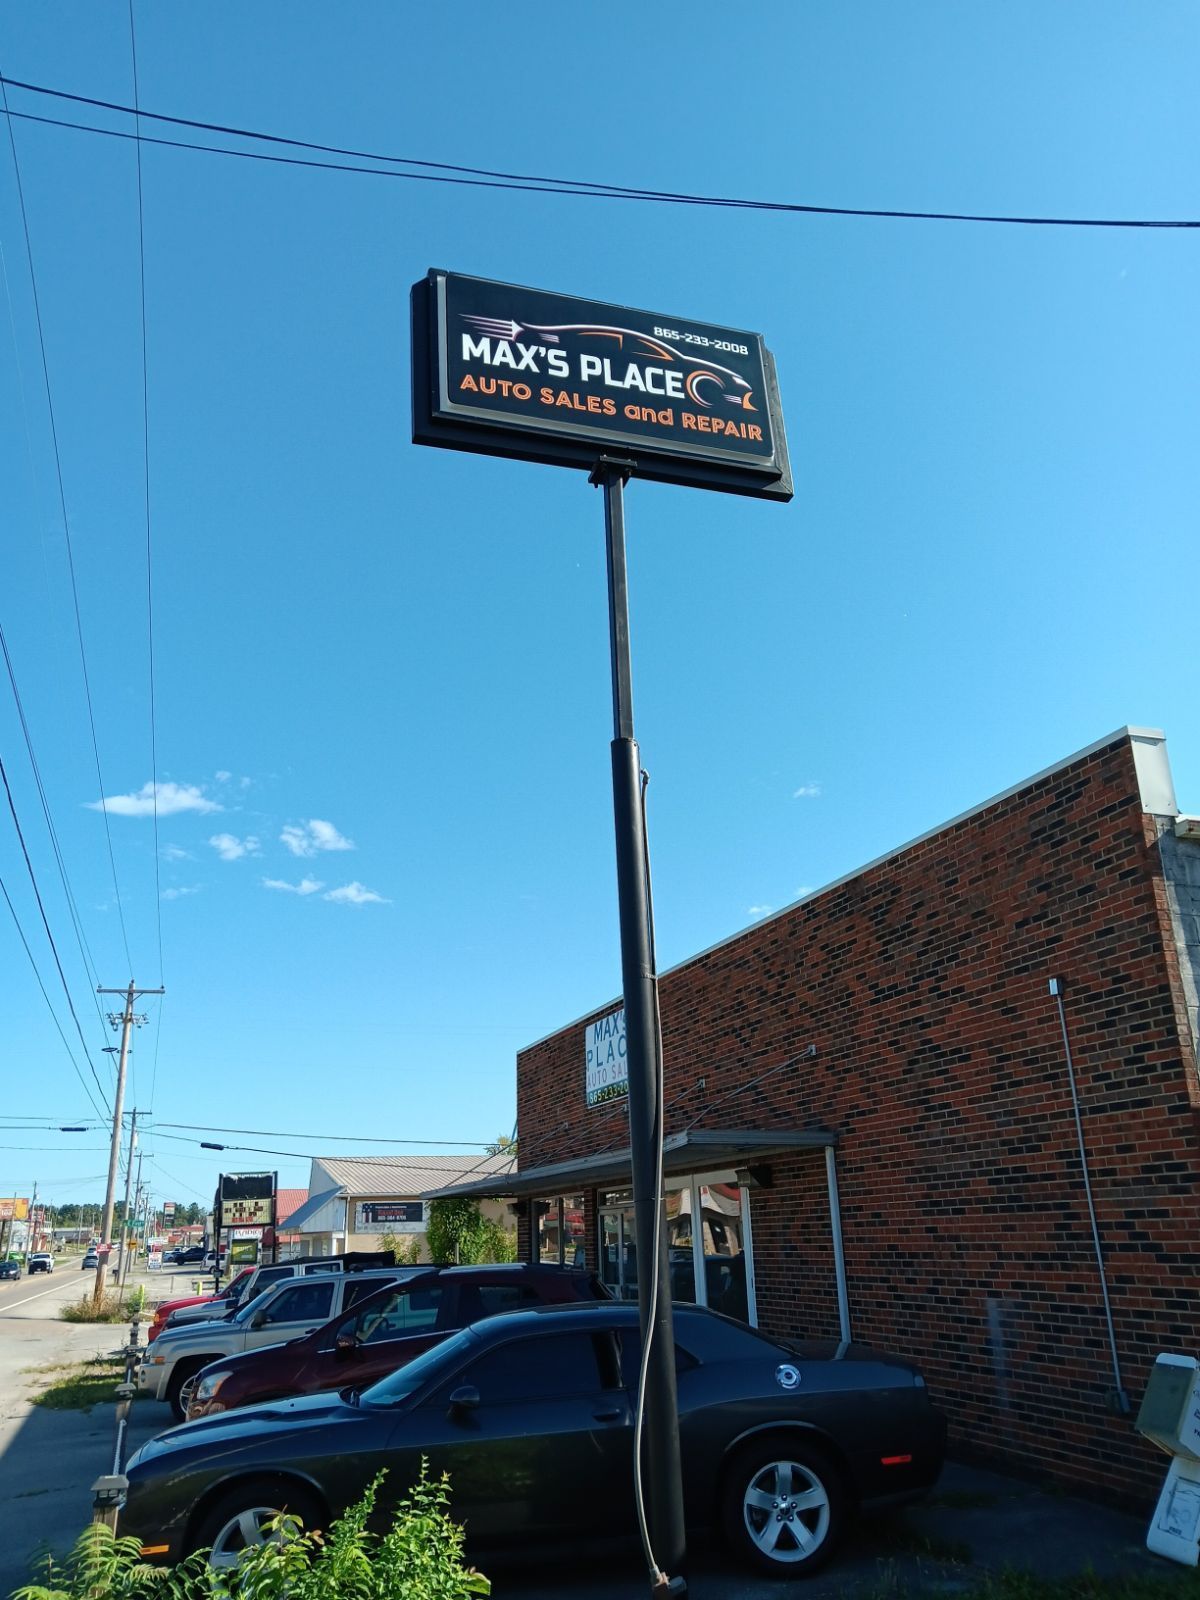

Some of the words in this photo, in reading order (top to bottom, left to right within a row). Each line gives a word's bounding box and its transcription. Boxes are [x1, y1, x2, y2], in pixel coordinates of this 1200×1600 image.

[654, 326, 748, 356] 865-233-2008
[462, 333, 569, 377] MAX'S
[581, 354, 685, 399] PLACE
[460, 374, 532, 400] AUTO
[540, 387, 617, 415] SALES
[624, 405, 673, 426] and
[682, 412, 763, 441] REPAIR
[587, 1034, 627, 1072] PLAC
[588, 1068, 607, 1088] AUTO
[612, 1060, 628, 1079] SAL
[589, 1080, 628, 1103] 865-233-20
